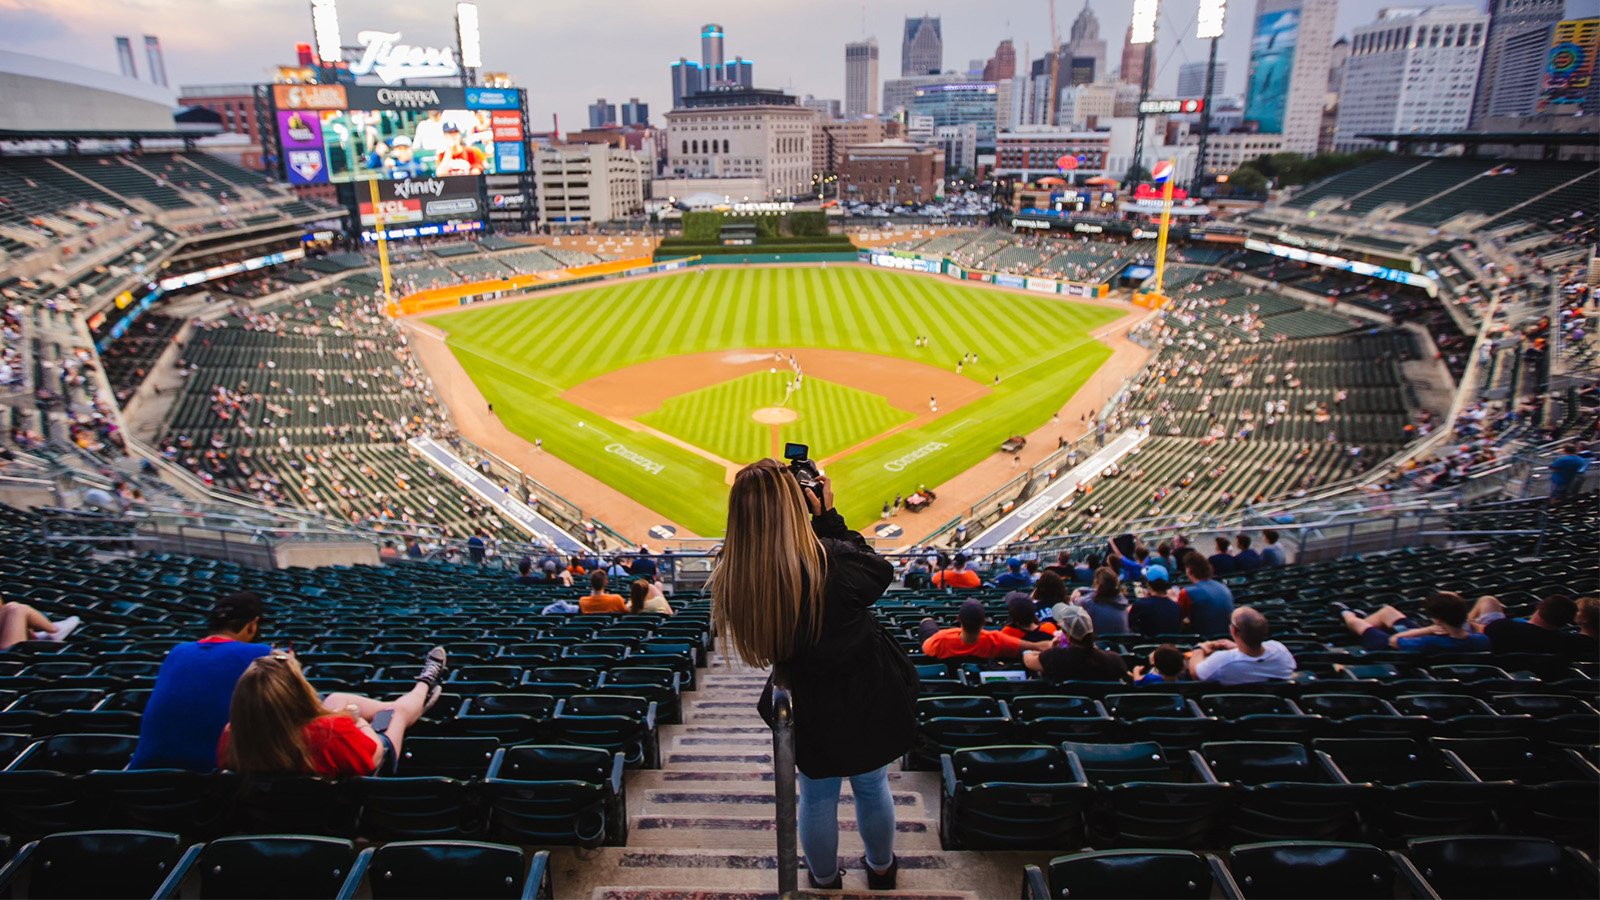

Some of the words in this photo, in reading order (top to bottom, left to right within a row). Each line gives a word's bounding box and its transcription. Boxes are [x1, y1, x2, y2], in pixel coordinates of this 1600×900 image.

[349, 30, 459, 85] Tigers
[1140, 101, 1181, 113] BELFOR
[393, 178, 445, 199] xfinity
[734, 202, 795, 212] CHEVROLET
